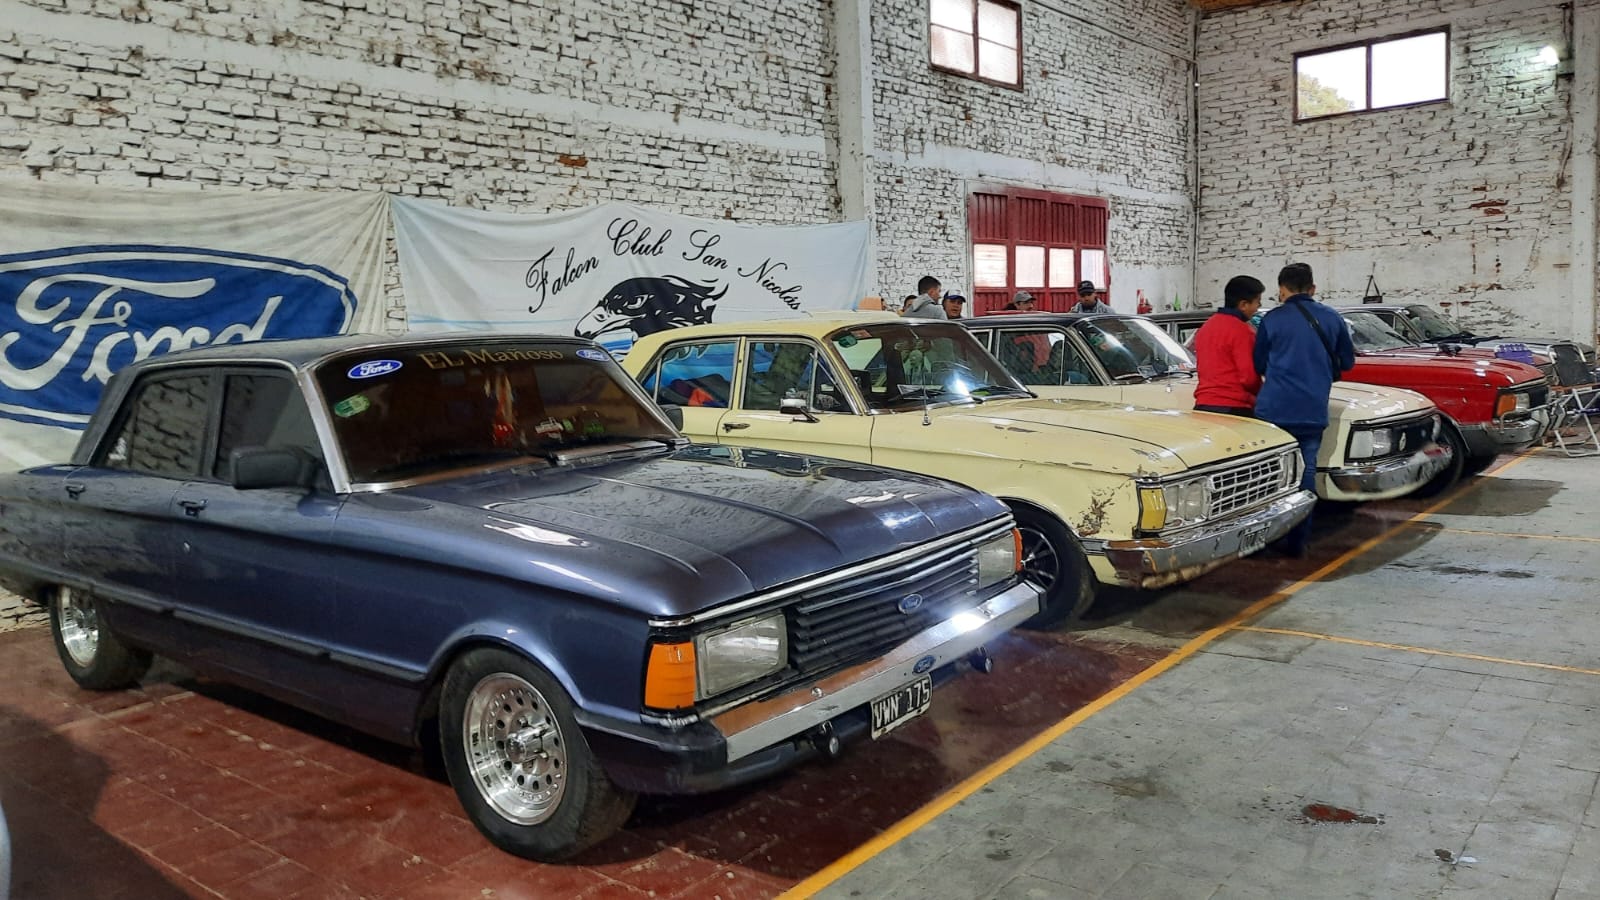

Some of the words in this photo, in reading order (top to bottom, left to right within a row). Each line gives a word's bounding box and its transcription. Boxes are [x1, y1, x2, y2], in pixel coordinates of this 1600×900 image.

[526, 247, 600, 314] Falcon
[606, 217, 673, 257] Club
[682, 229, 728, 270] San
[360, 362, 393, 377] Ford
[905, 679, 931, 712] 175
